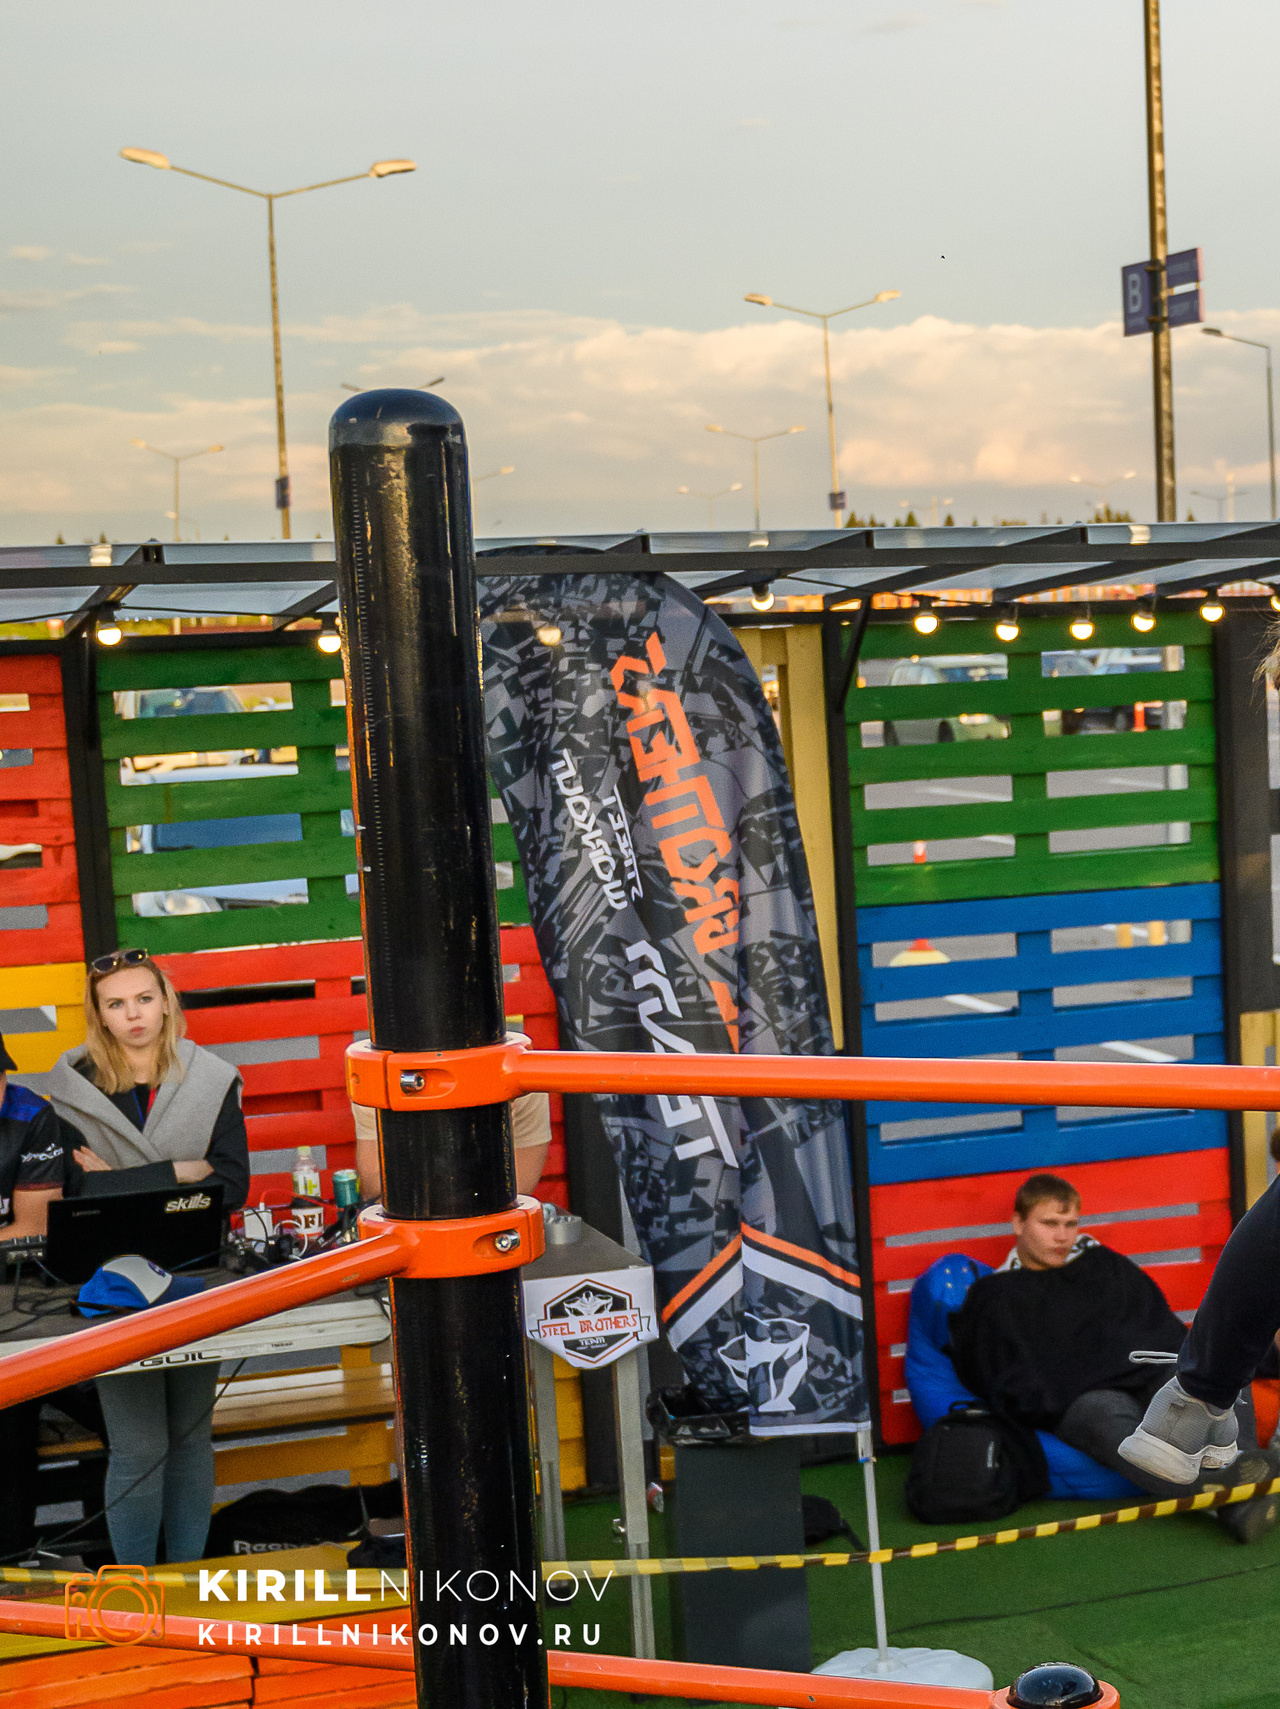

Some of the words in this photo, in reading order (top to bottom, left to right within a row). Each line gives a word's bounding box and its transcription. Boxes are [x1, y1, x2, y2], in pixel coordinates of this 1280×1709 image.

[165, 1192, 211, 1213] skills
[541, 1322, 576, 1338] STEEL
[579, 1313, 638, 1334] BROTHERS
[233, 1539, 320, 1555] Reeb
